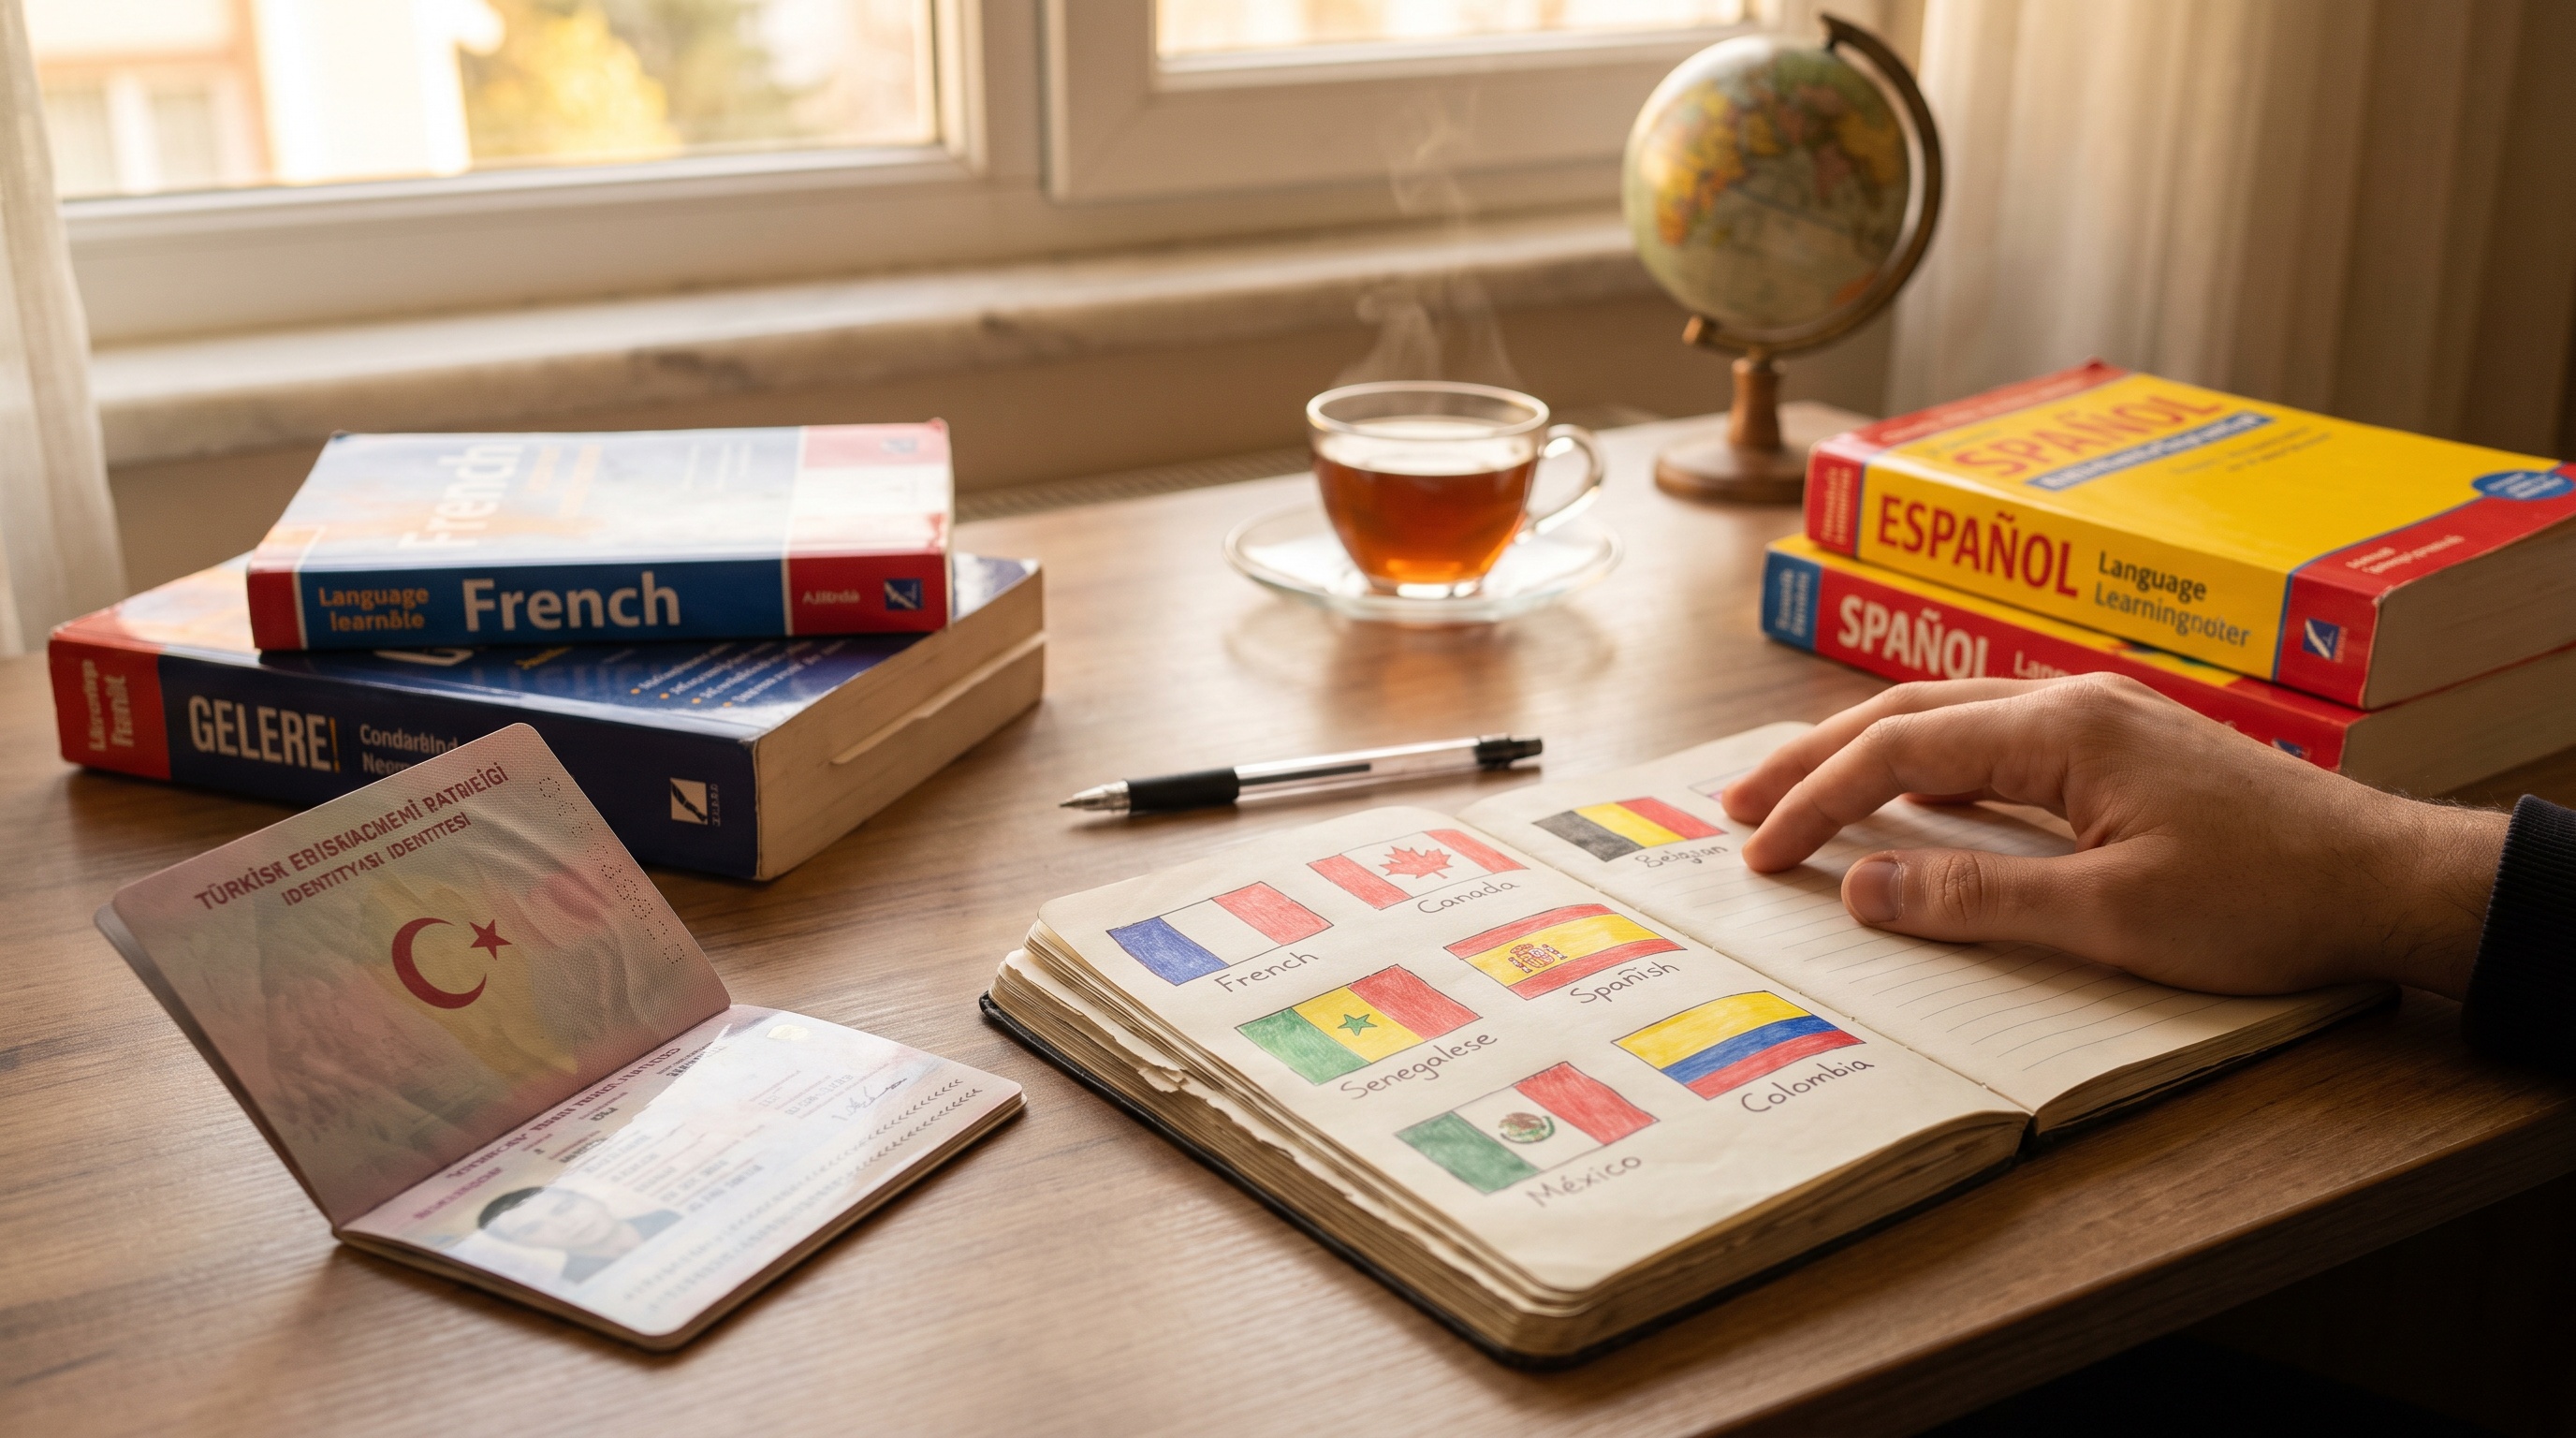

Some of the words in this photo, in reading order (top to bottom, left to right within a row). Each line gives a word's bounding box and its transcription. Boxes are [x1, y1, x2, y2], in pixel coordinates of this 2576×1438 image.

[1878, 493, 2078, 599] ESPAÑOL
[319, 587, 430, 611] Language
[462, 570, 681, 633] French
[2098, 550, 2207, 605] Language
[1417, 881, 1521, 914] Canada
[1214, 951, 1319, 992] French
[1340, 1034, 1498, 1100] Senegalese
[1741, 1061, 1875, 1112] Colombia
[1526, 1156, 1642, 1208] México
